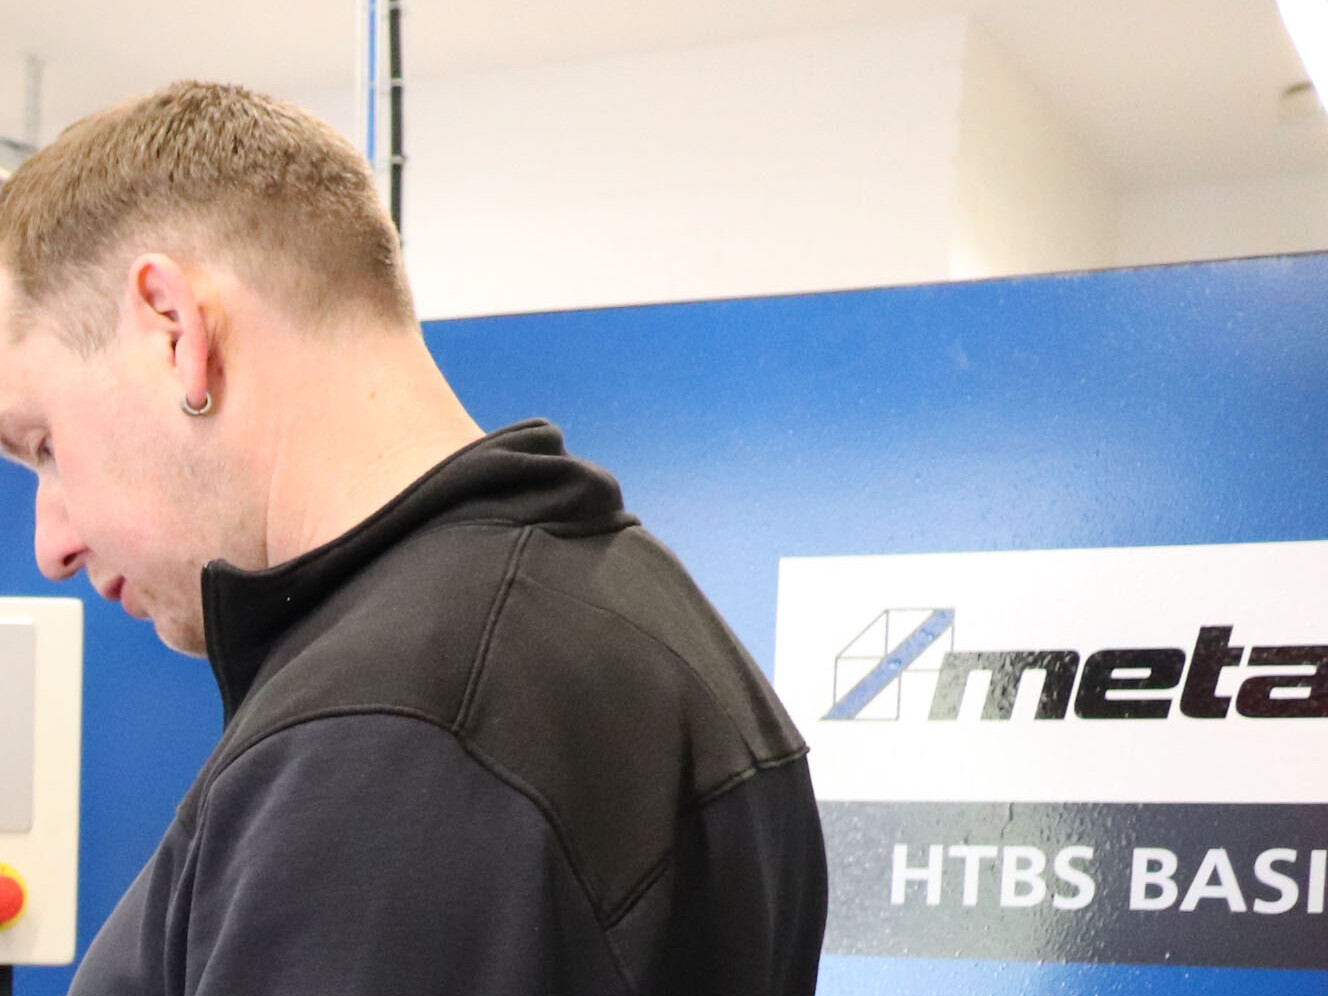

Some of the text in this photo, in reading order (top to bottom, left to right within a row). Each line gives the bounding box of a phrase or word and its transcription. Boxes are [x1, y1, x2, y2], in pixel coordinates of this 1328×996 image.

[928, 624, 1328, 721] meta
[891, 843, 1328, 915] HTBS BASI
